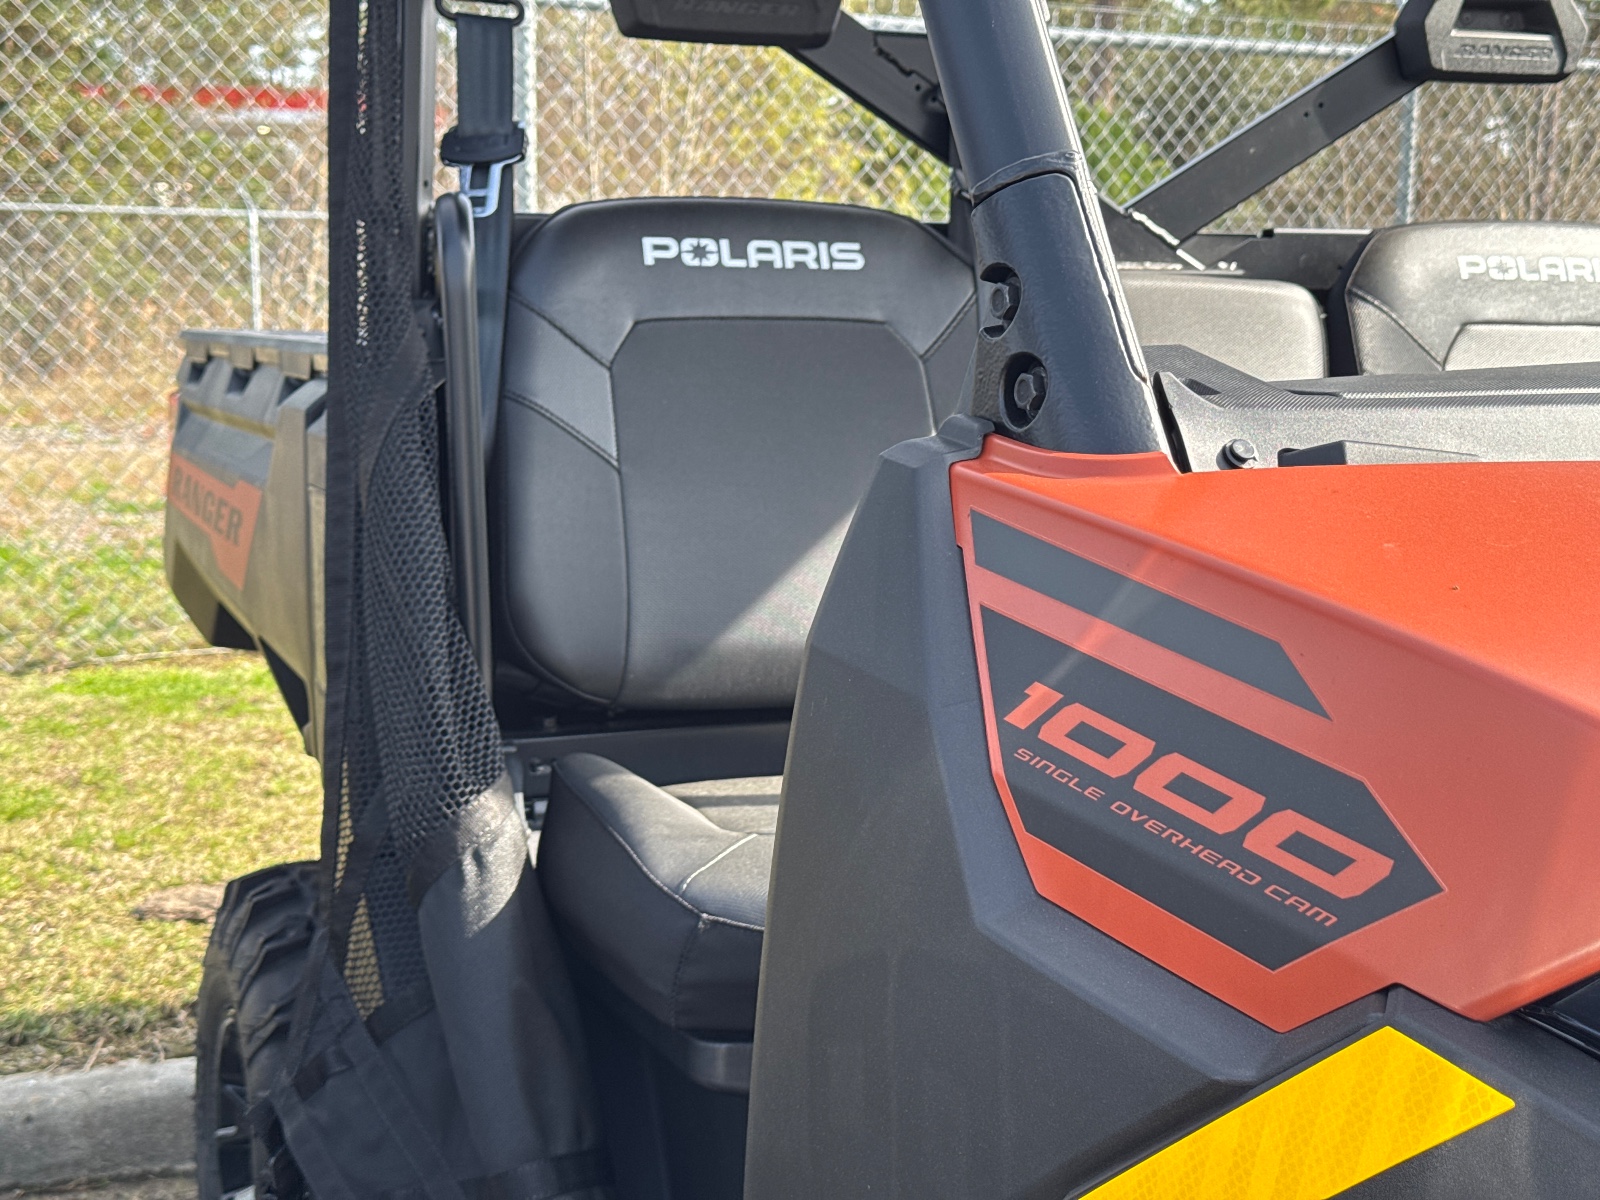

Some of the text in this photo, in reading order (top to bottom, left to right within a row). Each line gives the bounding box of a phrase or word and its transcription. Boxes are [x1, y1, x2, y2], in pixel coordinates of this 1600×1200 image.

[641, 236, 865, 270] POLARIS
[171, 465, 243, 546] RANGER
[1003, 681, 1394, 899] 1000
[1013, 747, 1338, 927] SINGLE OVERHEAD CAM
